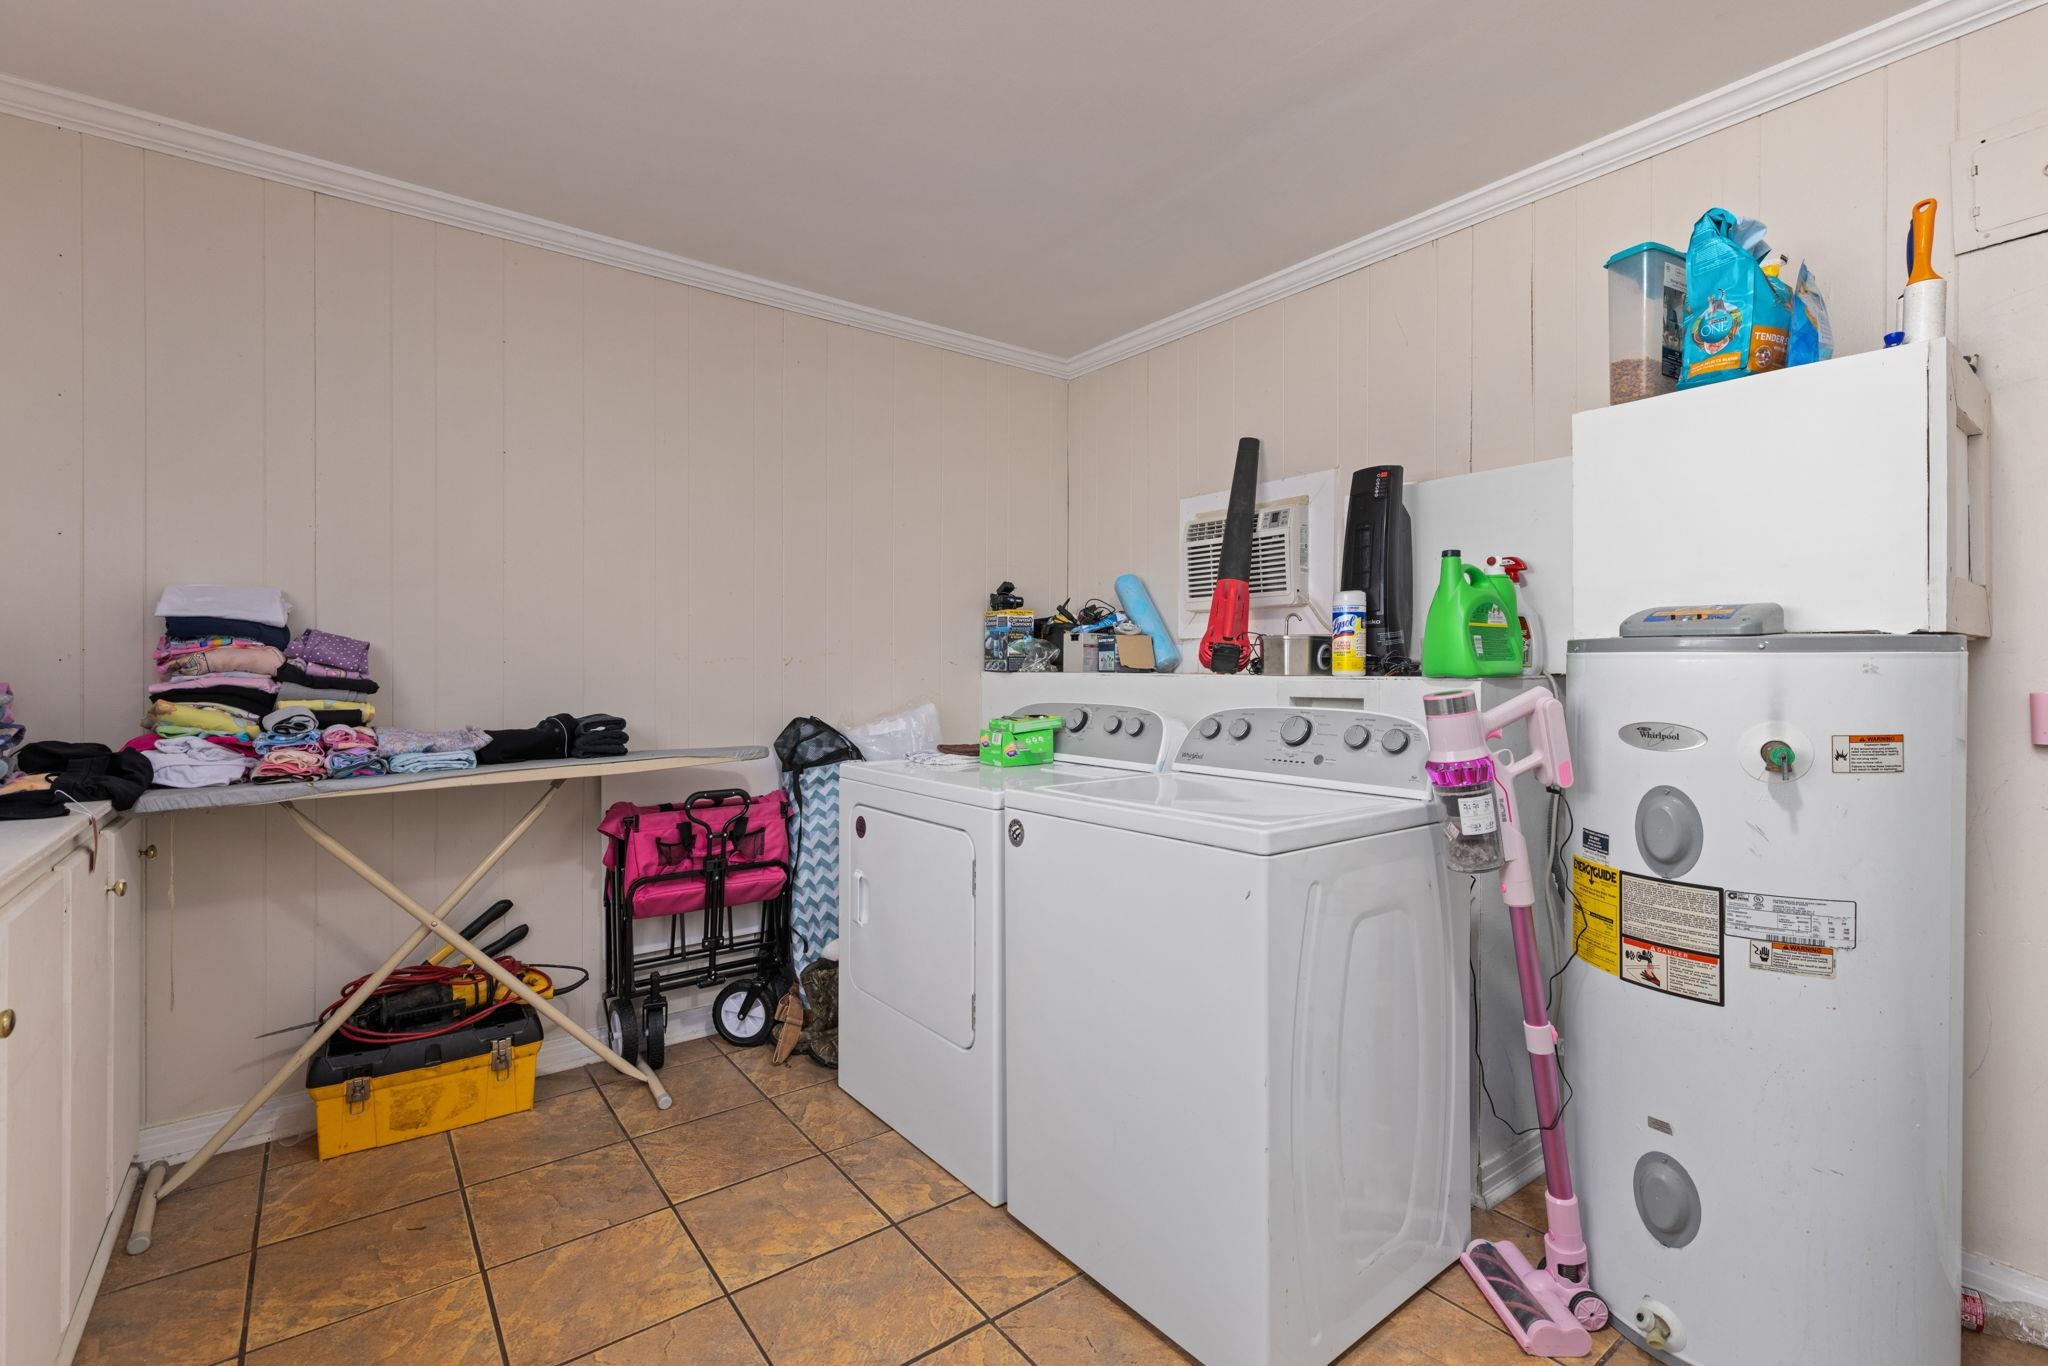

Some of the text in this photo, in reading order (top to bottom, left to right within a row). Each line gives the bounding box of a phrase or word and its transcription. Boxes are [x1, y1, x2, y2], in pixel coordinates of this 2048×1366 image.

[1700, 322, 1728, 337] ONE
[1755, 331, 1784, 342] TENDER
[1333, 616, 1355, 632] Lysol
[1640, 731, 1680, 741] Whirlpool
[1657, 947, 1688, 958] DANGER
[1790, 945, 1822, 953] WARNING
